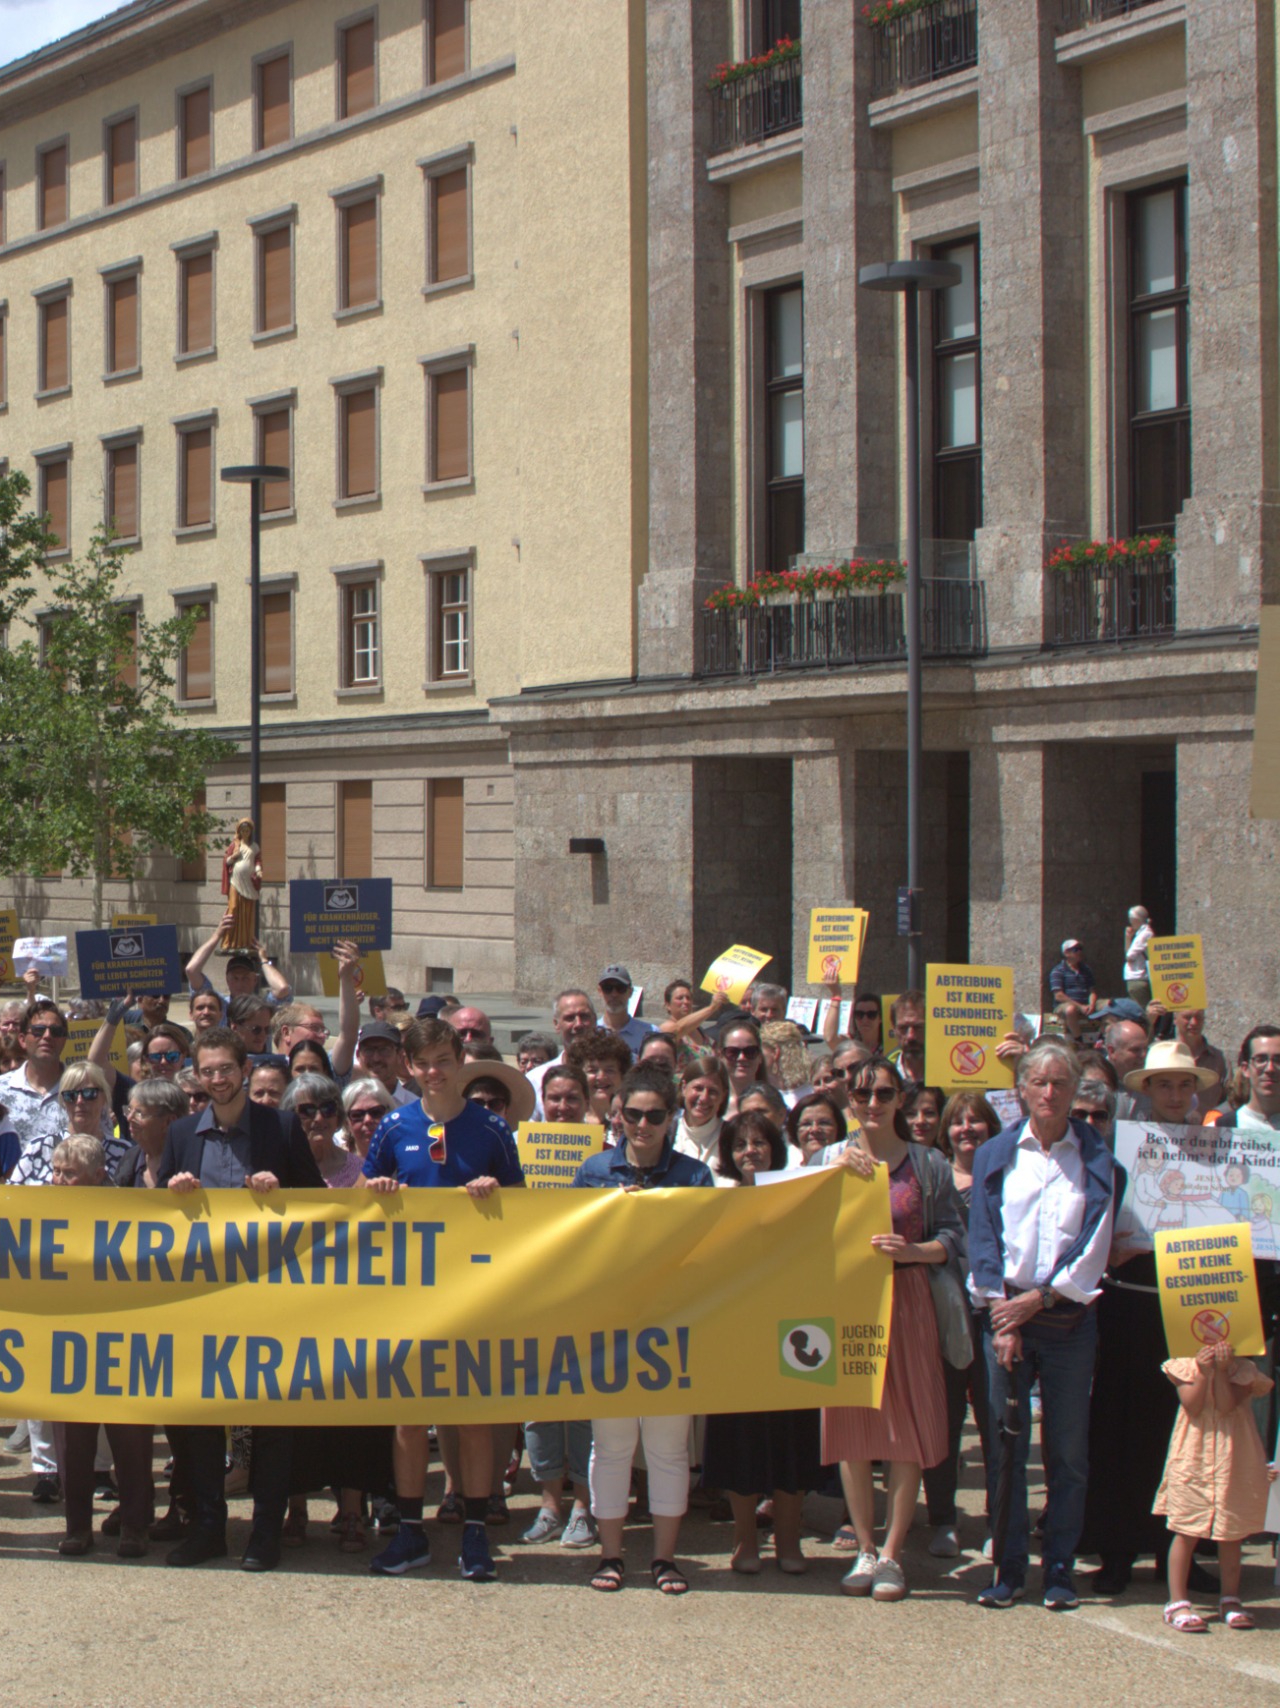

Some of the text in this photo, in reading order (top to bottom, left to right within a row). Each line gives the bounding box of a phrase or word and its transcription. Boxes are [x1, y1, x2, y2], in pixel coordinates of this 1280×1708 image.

[936, 975, 1002, 988] ABTREIBUNG
[947, 991, 995, 1004] IST KEINE
[933, 1007, 1008, 1020] GESUNDHEITS-
[944, 1025, 997, 1037] LEISTUNG!
[527, 1132, 591, 1146] ABTREIBUNG
[1146, 1132, 1276, 1152] Bevor du abtreibst,
[536, 1149, 584, 1162] IST KEINE
[1137, 1147, 1158, 1159] ich
[1208, 1152, 1237, 1165] dein
[1166, 1235, 1238, 1254] ABTREIBUNG
[93, 1220, 445, 1286] KRANKHEIT
[1178, 1254, 1232, 1270] IST KEINE
[1165, 1271, 1249, 1289] GESUNDHEITS-
[1180, 1290, 1239, 1307] LEISTUNG!
[842, 1325, 884, 1339] JUGEND
[842, 1340, 887, 1358] FÜR DAS
[51, 1331, 174, 1398] DEM
[201, 1326, 692, 1400] KRANKENHAUS!
[843, 1361, 877, 1375] LEBEN
